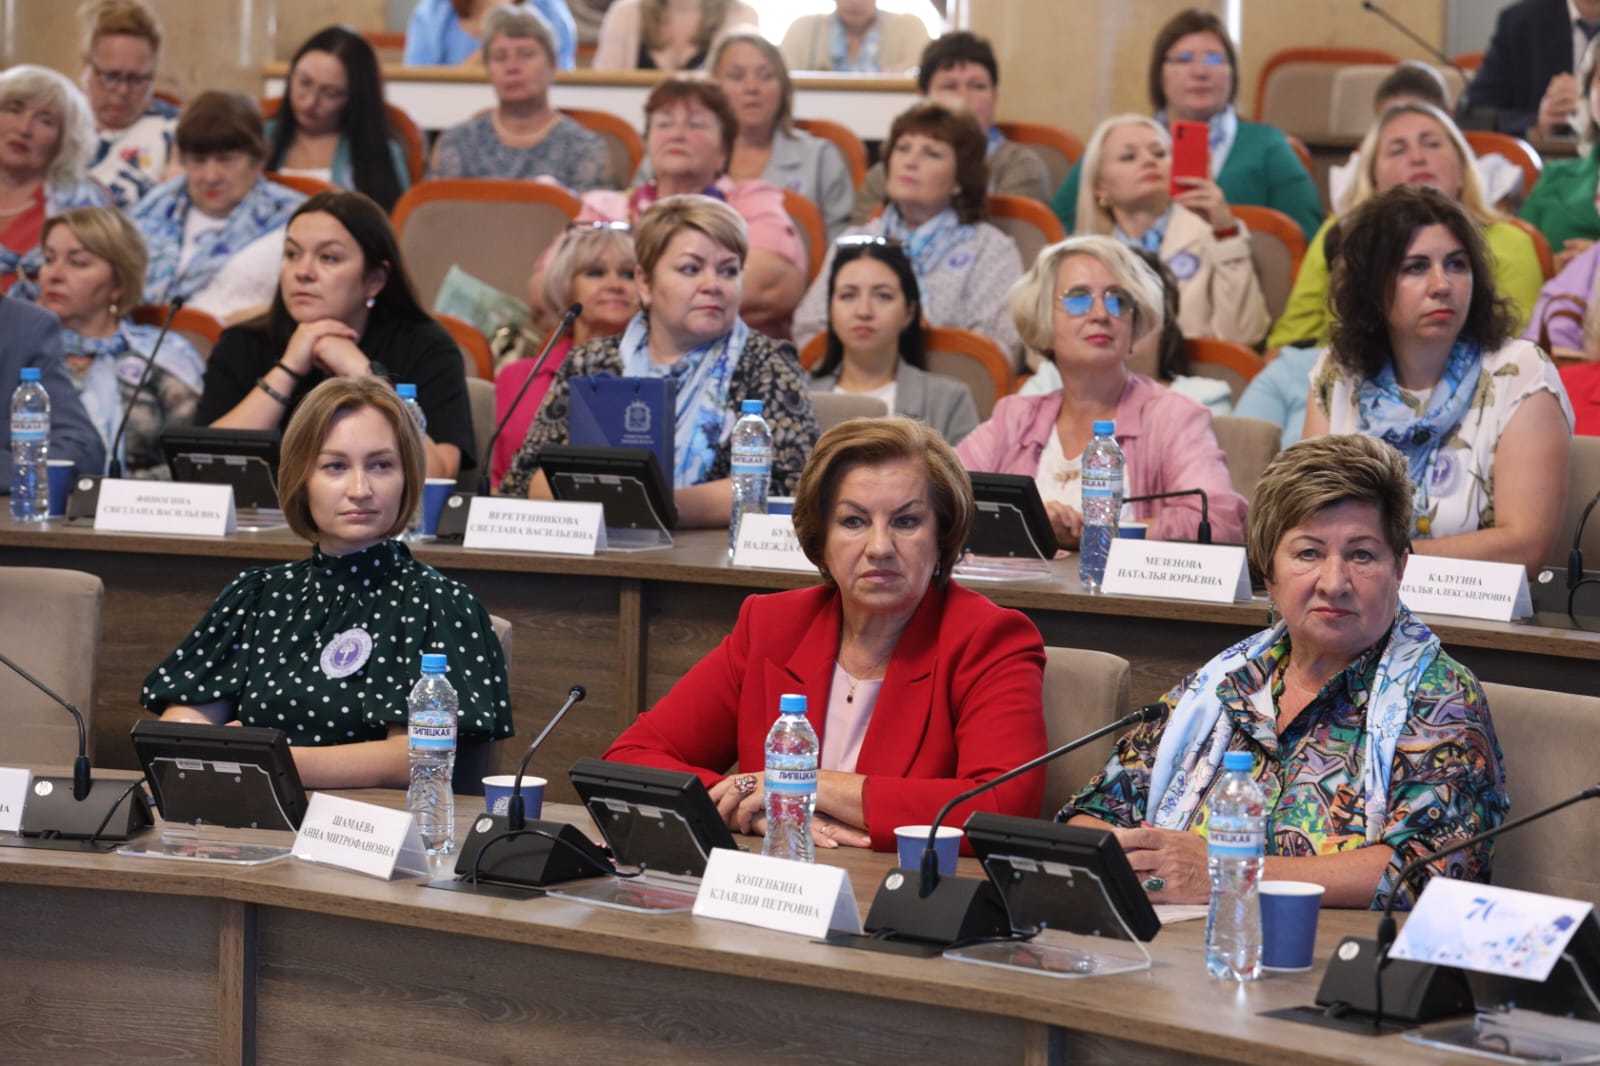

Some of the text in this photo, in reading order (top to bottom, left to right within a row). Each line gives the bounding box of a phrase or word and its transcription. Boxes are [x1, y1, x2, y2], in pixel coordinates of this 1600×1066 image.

[103, 505, 221, 520] СВЕТЛАНА ВАСИЛЬЕВНА
[488, 511, 579, 526] ВЕРЕТЕННИКОВА
[470, 523, 594, 540] СВЕТЛАНА ВАСИЛЬЕВНА
[743, 540, 795, 553] НАДЕЖДА
[1145, 556, 1203, 570] МЕЗЕНОВА
[1118, 568, 1223, 586] НАТАЛЬЯ ЮРЬЕВНА
[1428, 573, 1483, 587] КАЛУГИНА
[1401, 584, 1512, 603] АТАЛЬЯ АЛЕКСАНДРОВНА
[332, 815, 375, 835] ШАМАЕВА
[302, 827, 396, 858] АННА МИТРОФАНОВНА
[735, 872, 804, 896] КОПЕНКИНА
[710, 888, 820, 920] КЛАВДИЯ ПЕТРОВНА
